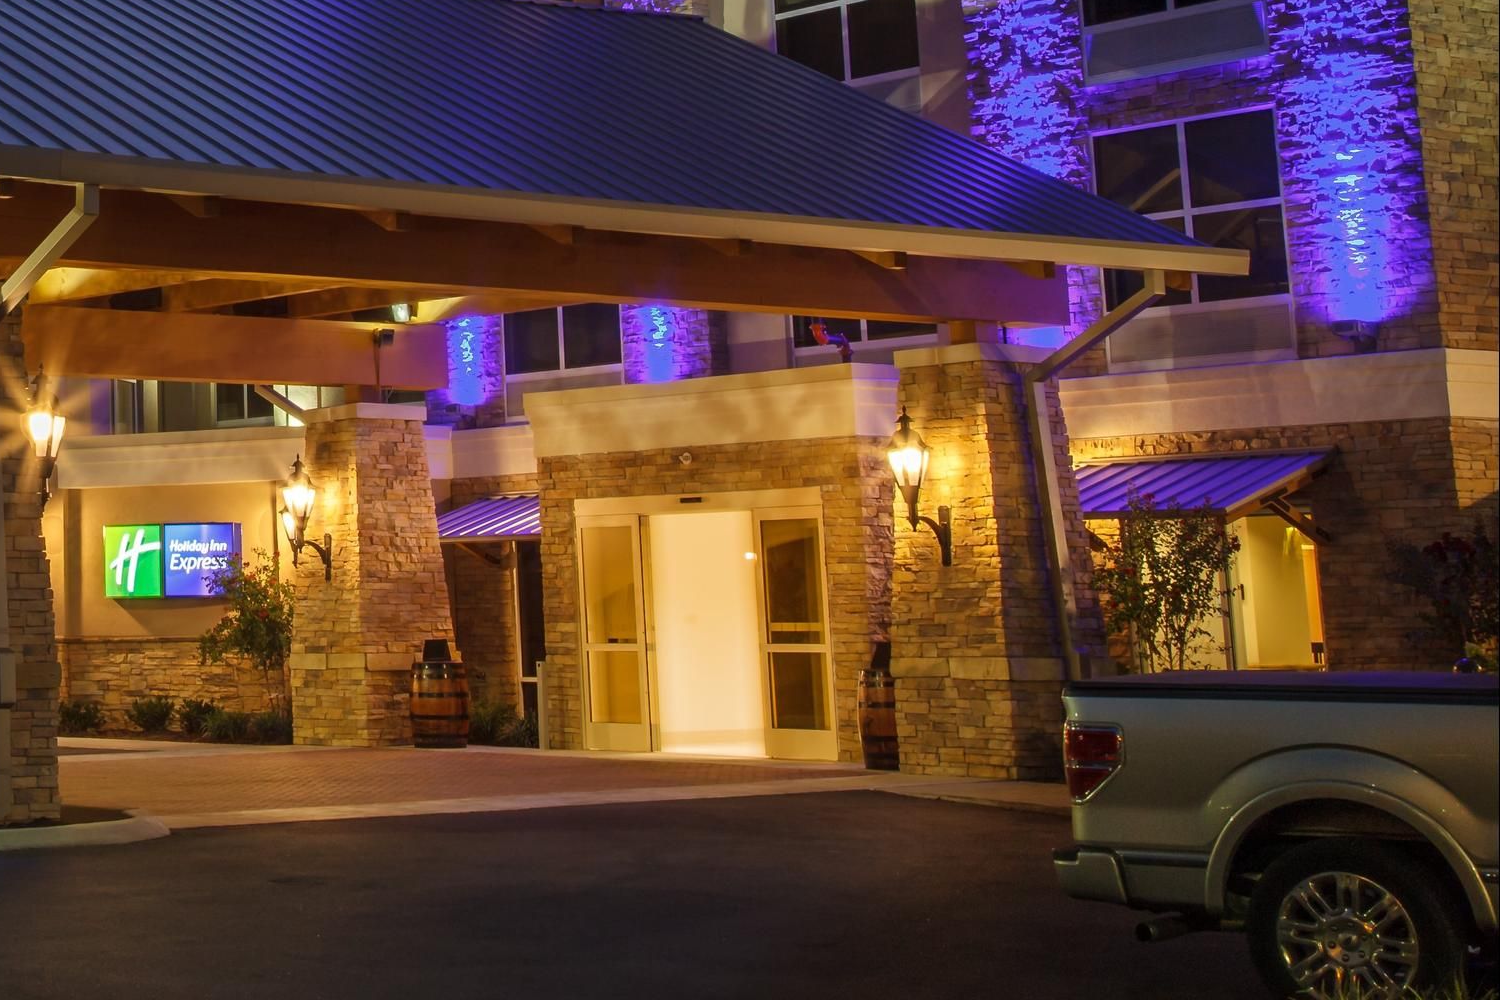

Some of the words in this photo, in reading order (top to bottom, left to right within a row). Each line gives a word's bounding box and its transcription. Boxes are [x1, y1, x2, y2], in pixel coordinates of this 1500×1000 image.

[170, 539, 209, 554] Holiday
[210, 539, 227, 551] Inn
[110, 529, 161, 592] H
[170, 554, 227, 574] Express
